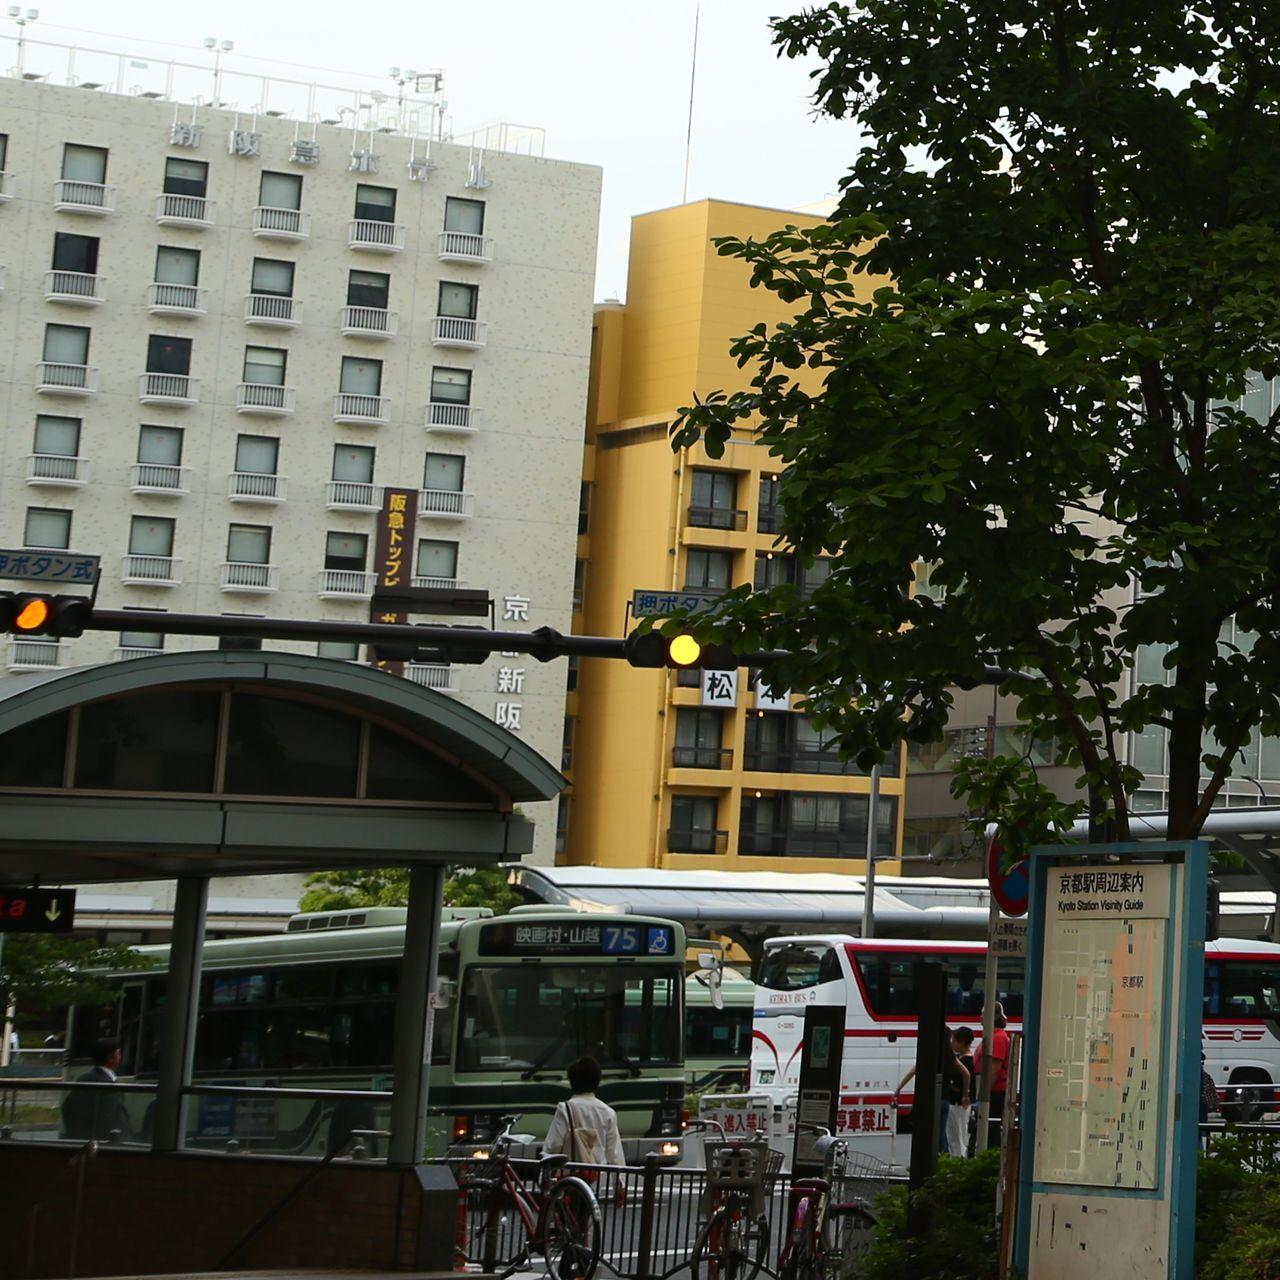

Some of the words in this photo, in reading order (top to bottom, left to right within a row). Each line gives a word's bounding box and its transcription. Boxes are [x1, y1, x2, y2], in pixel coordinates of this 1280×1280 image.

[170, 121, 492, 190] 新阪急ホテル
[1060, 871, 1144, 894] 京都駅周辺案内
[1058, 901, 1076, 913] Kyoto
[1077, 900, 1100, 911] Station
[1124, 899, 1144, 910] Guide
[1264, 915, 1270, 930] 7
[606, 927, 636, 950] 75
